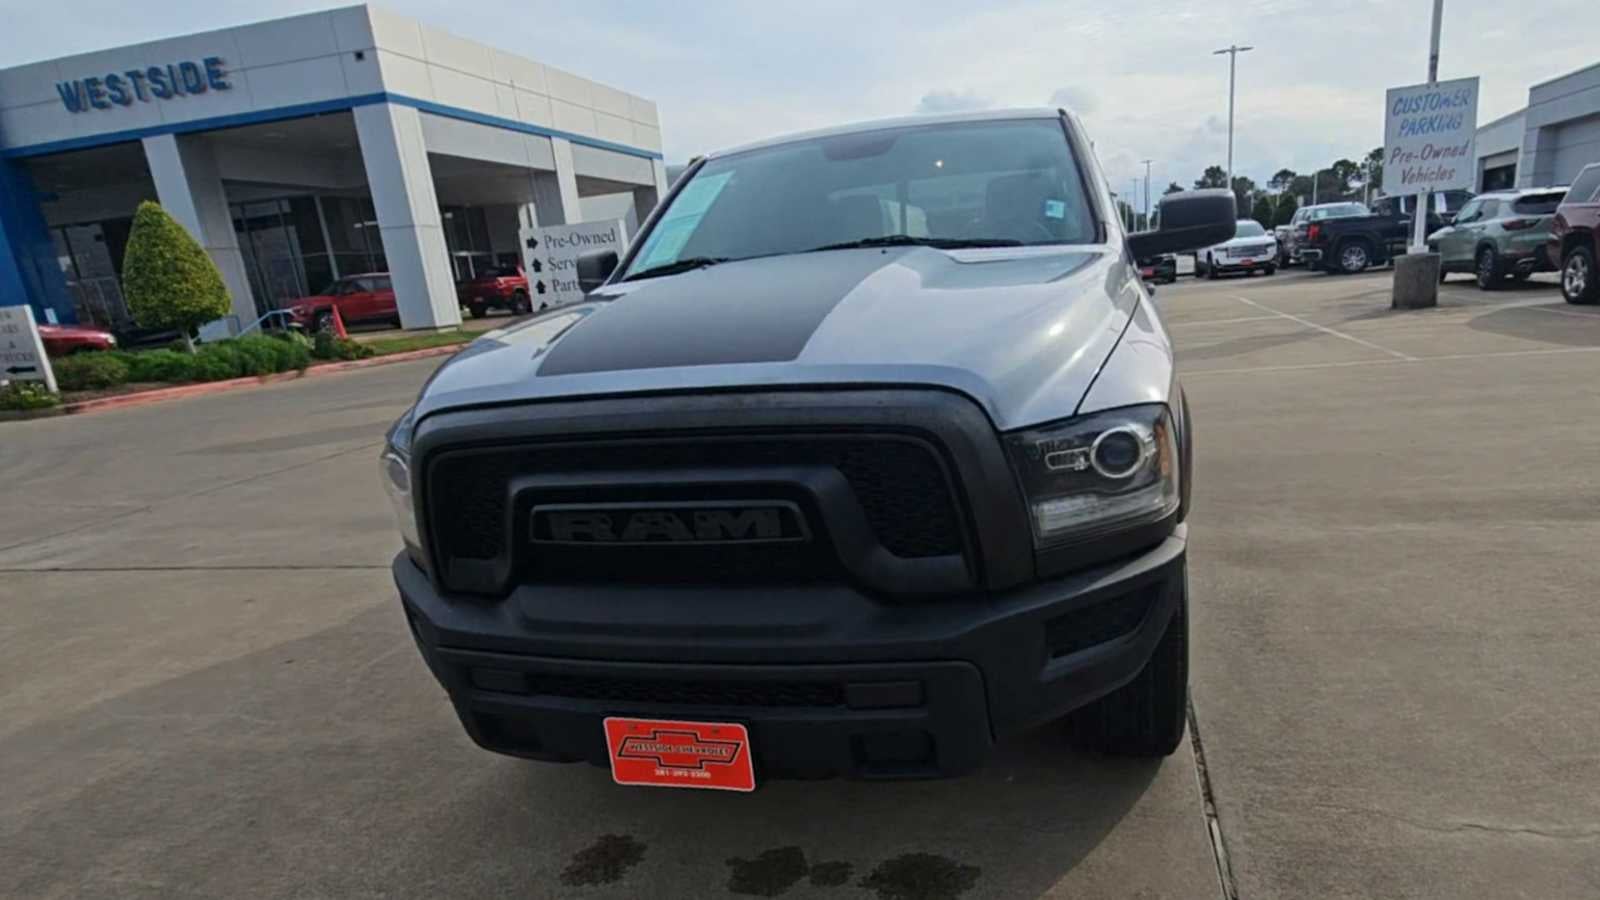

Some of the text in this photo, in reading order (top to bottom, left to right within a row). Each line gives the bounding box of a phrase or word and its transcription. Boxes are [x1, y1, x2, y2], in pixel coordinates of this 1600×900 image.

[56, 56, 231, 113] WESTSIDE
[1392, 88, 1472, 117] CUSTOMER
[1399, 112, 1464, 137] PARKING
[1389, 138, 1471, 165] Pre-Owned
[1400, 164, 1456, 184] Vehicles
[543, 227, 616, 250] Pre-Owned
[546, 257, 577, 272] Serv
[551, 278, 580, 293] Part
[548, 508, 782, 541] RAM
